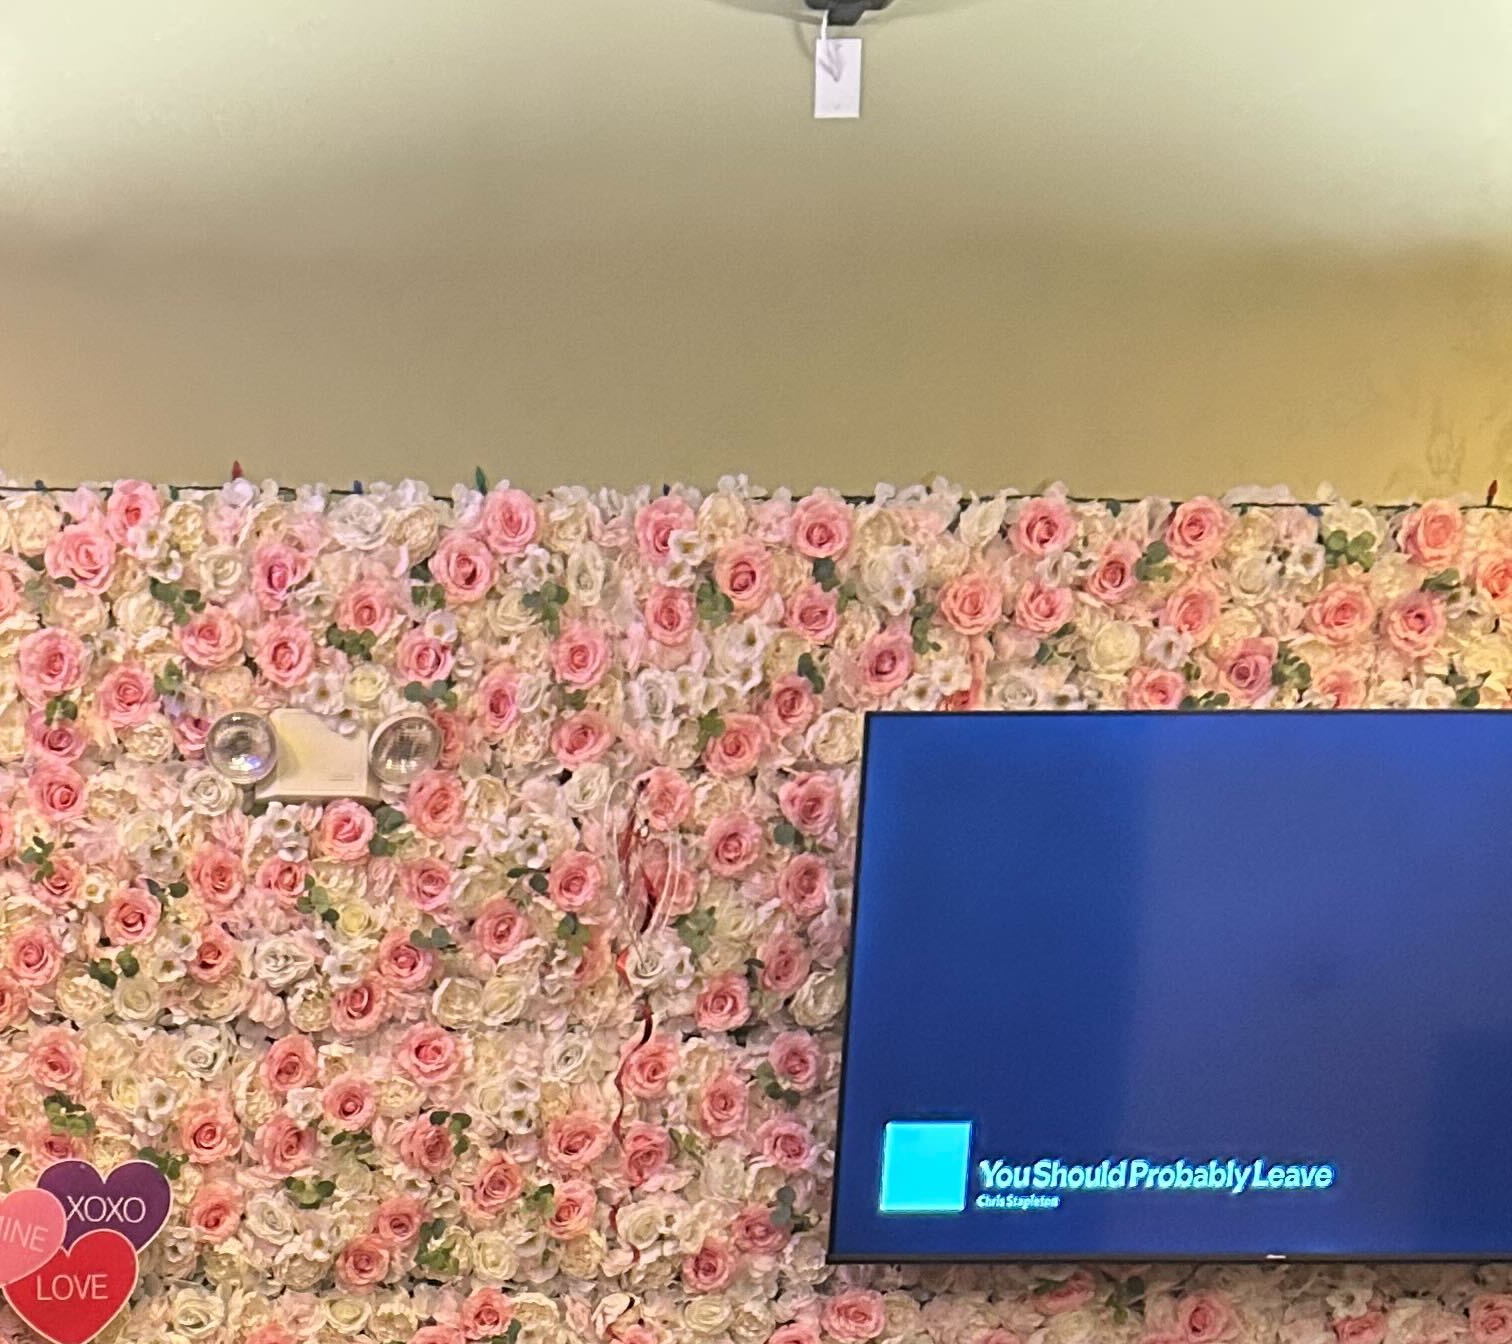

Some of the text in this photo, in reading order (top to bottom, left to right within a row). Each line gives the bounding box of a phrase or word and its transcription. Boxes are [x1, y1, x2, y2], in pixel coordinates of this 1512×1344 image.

[978, 1159, 1334, 1194] You Should Probably Leave
[66, 1195, 146, 1223] XOXO
[37, 1274, 109, 1301] LOVE
